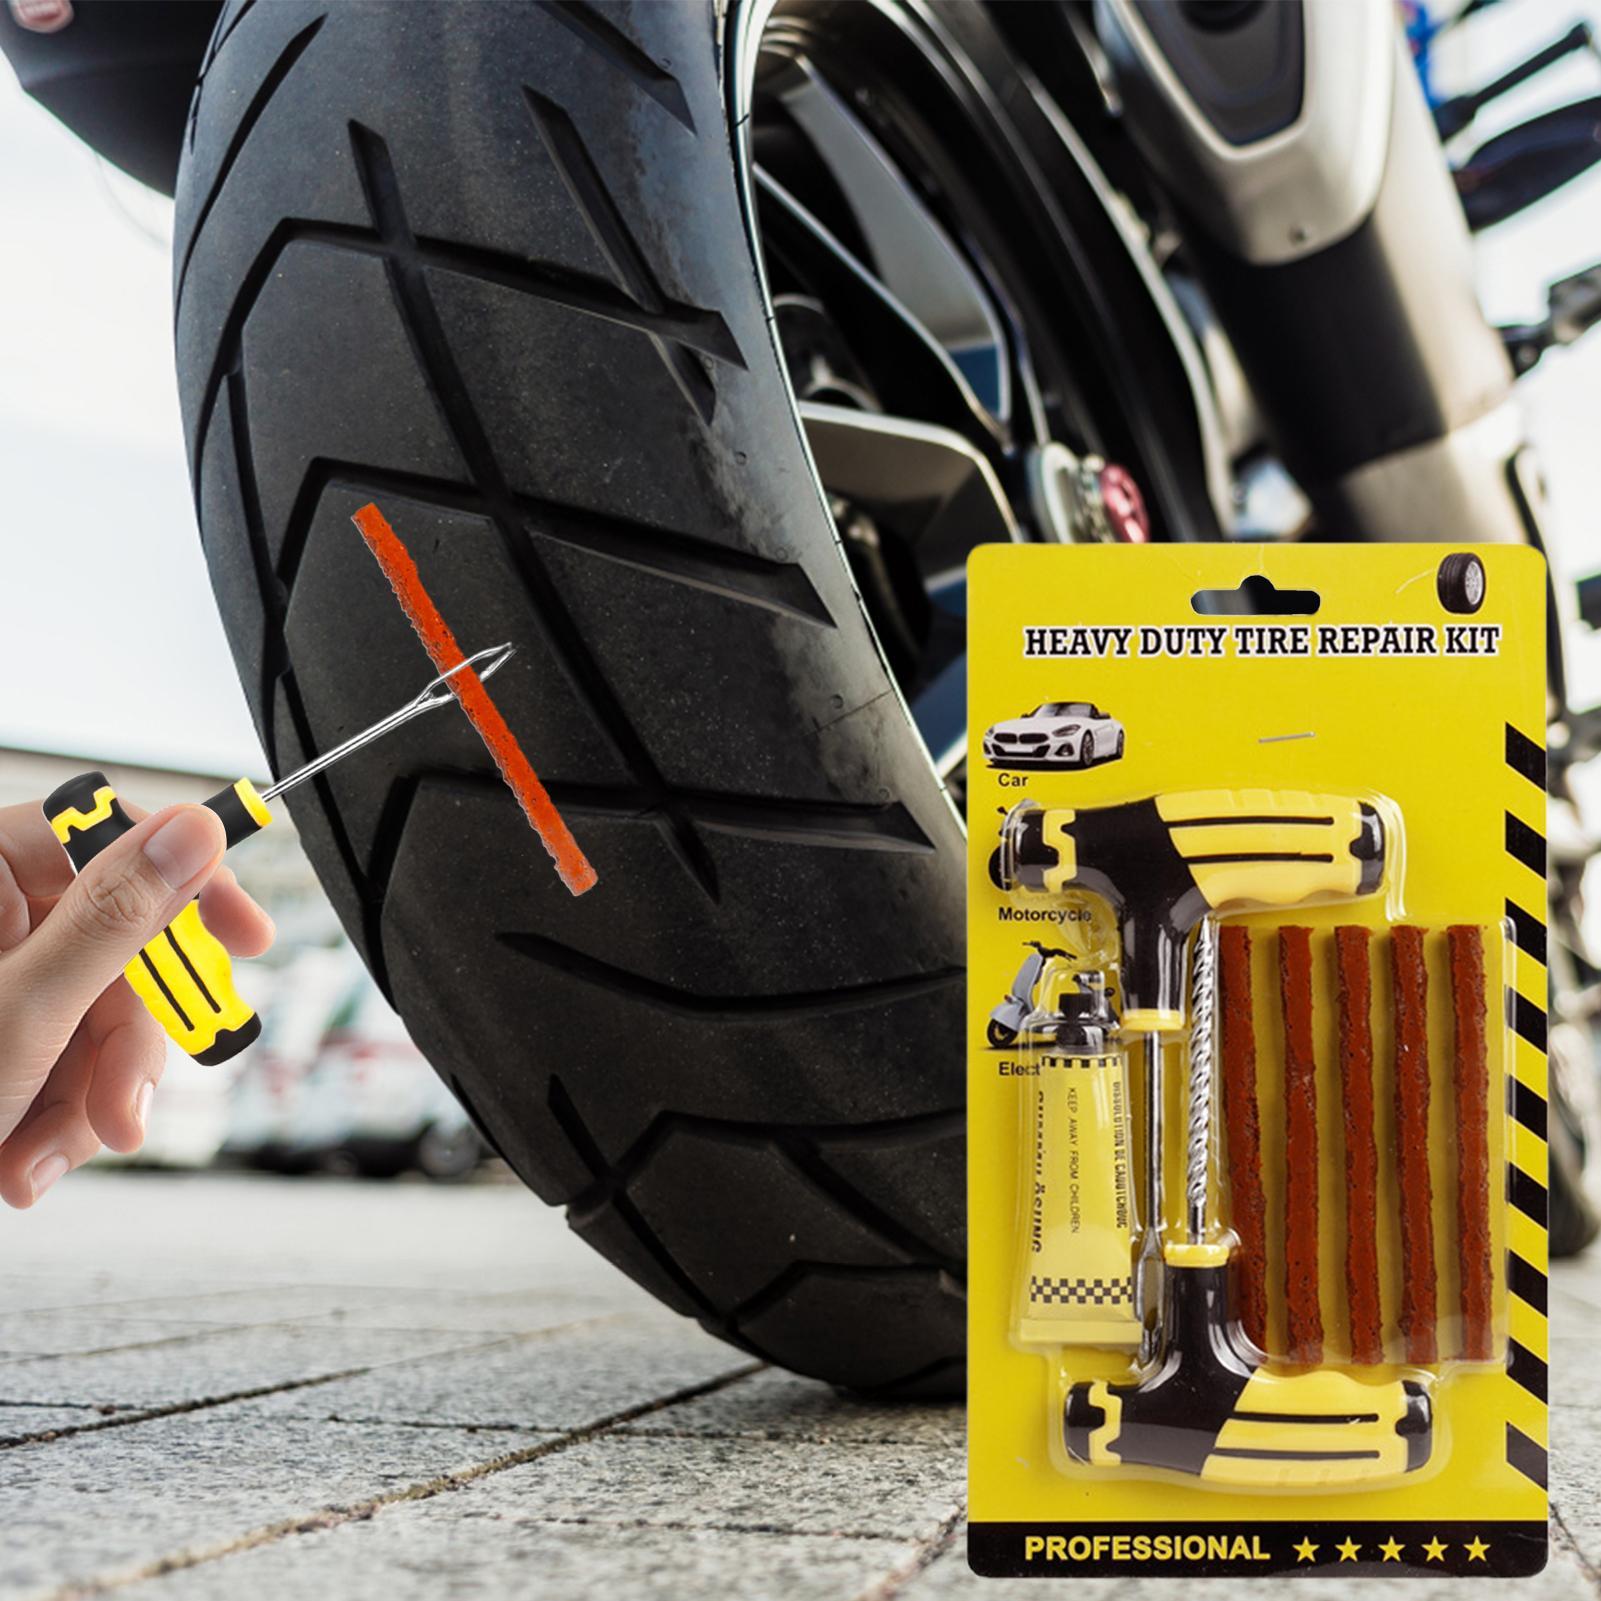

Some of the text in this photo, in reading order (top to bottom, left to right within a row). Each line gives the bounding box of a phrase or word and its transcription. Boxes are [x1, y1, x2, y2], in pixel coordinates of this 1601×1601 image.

[1024, 626, 1500, 656] HEAVY DUTY TIRE REPAIR KIT
[997, 772, 1028, 787] Car
[998, 906, 1093, 925] Motorcycle
[1067, 1087, 1080, 1234] KEEP AWAY FROM CHILDREN
[1024, 1535, 1271, 1561] PROFESSIONAL
